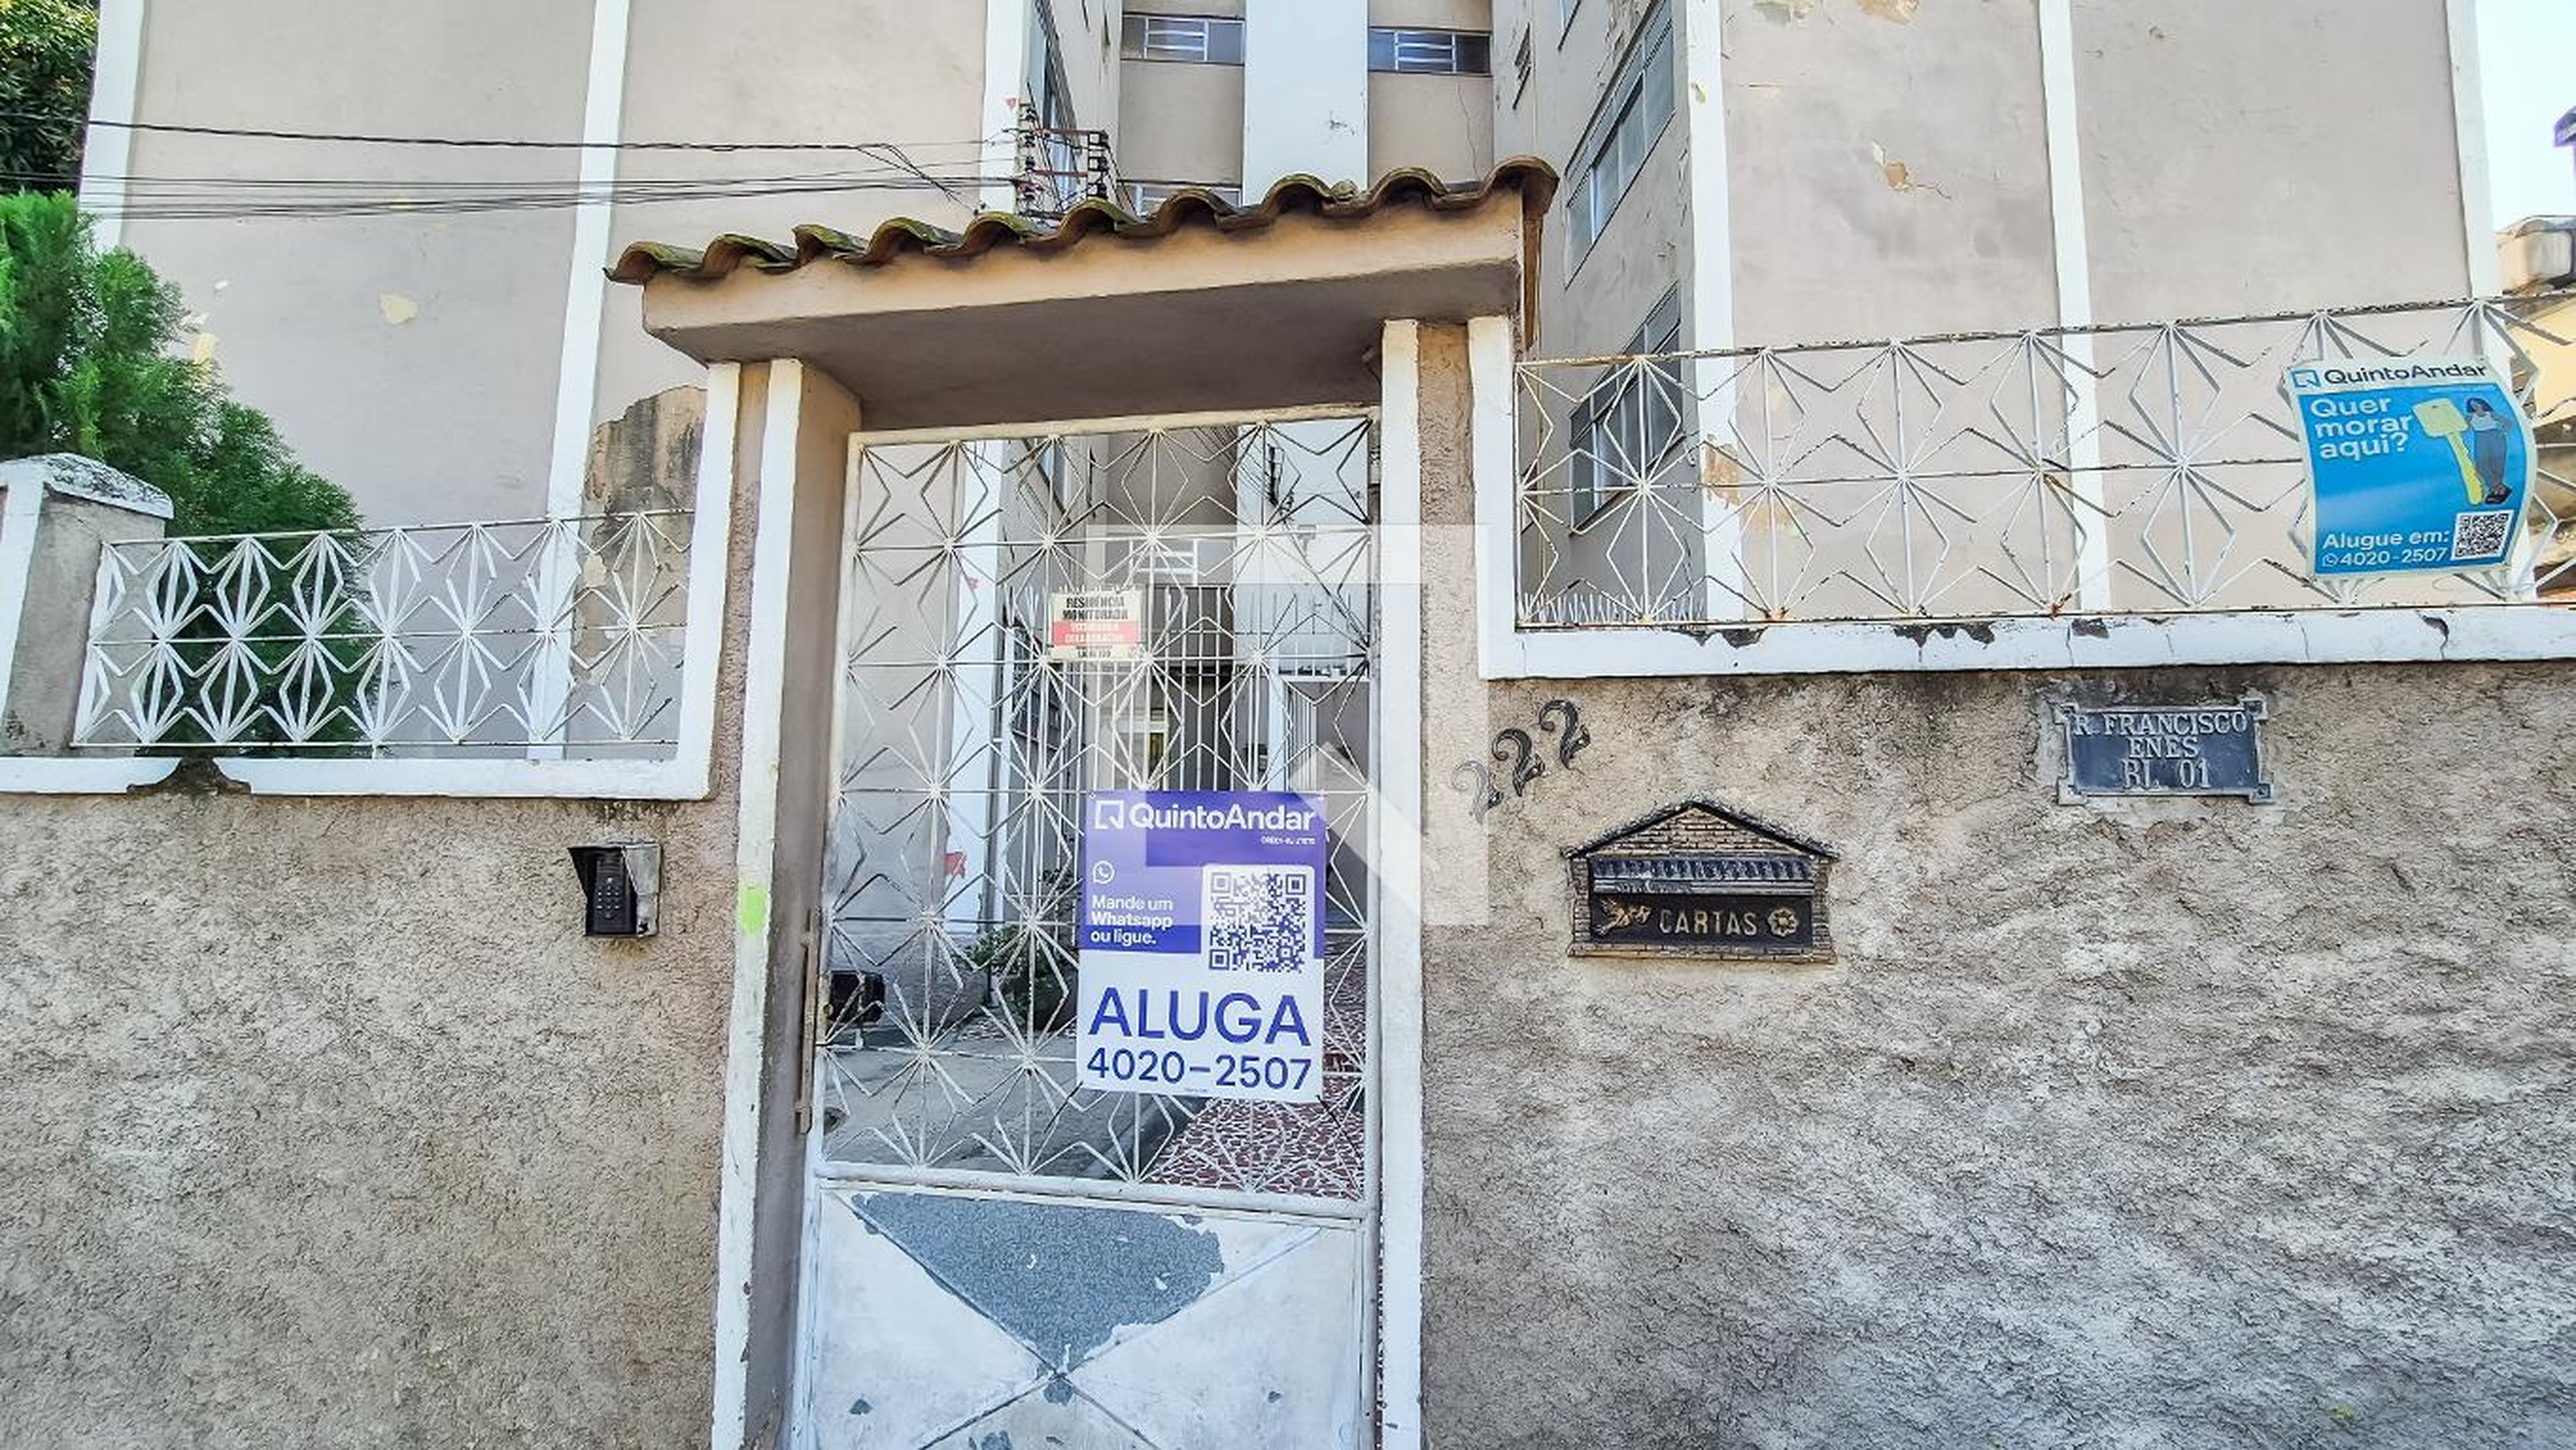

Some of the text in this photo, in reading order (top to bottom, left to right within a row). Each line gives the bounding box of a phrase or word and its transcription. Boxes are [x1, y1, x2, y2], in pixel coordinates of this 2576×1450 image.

[2324, 364, 2488, 384] QuintoAndar
[2310, 398, 2391, 419] Quer
[2315, 414, 2413, 438] morar
[2320, 433, 2409, 461] aqui?
[2322, 528, 2451, 550] Alugue em:
[2103, 712, 2247, 736] FRANCISCO
[2129, 737, 2199, 759] ENES
[1450, 700, 1591, 824] 222
[2180, 758, 2212, 788] 01
[1129, 803, 1316, 831] QuintoAndar
[1091, 895, 1173, 911] Mande um
[1091, 911, 1173, 930] Whatsapp
[1660, 909, 1759, 936] CARTAS
[1091, 927, 1157, 946] ou ligue.
[1087, 987, 1311, 1047] ALUGA
[1087, 1048, 1312, 1091] 4020-2507
